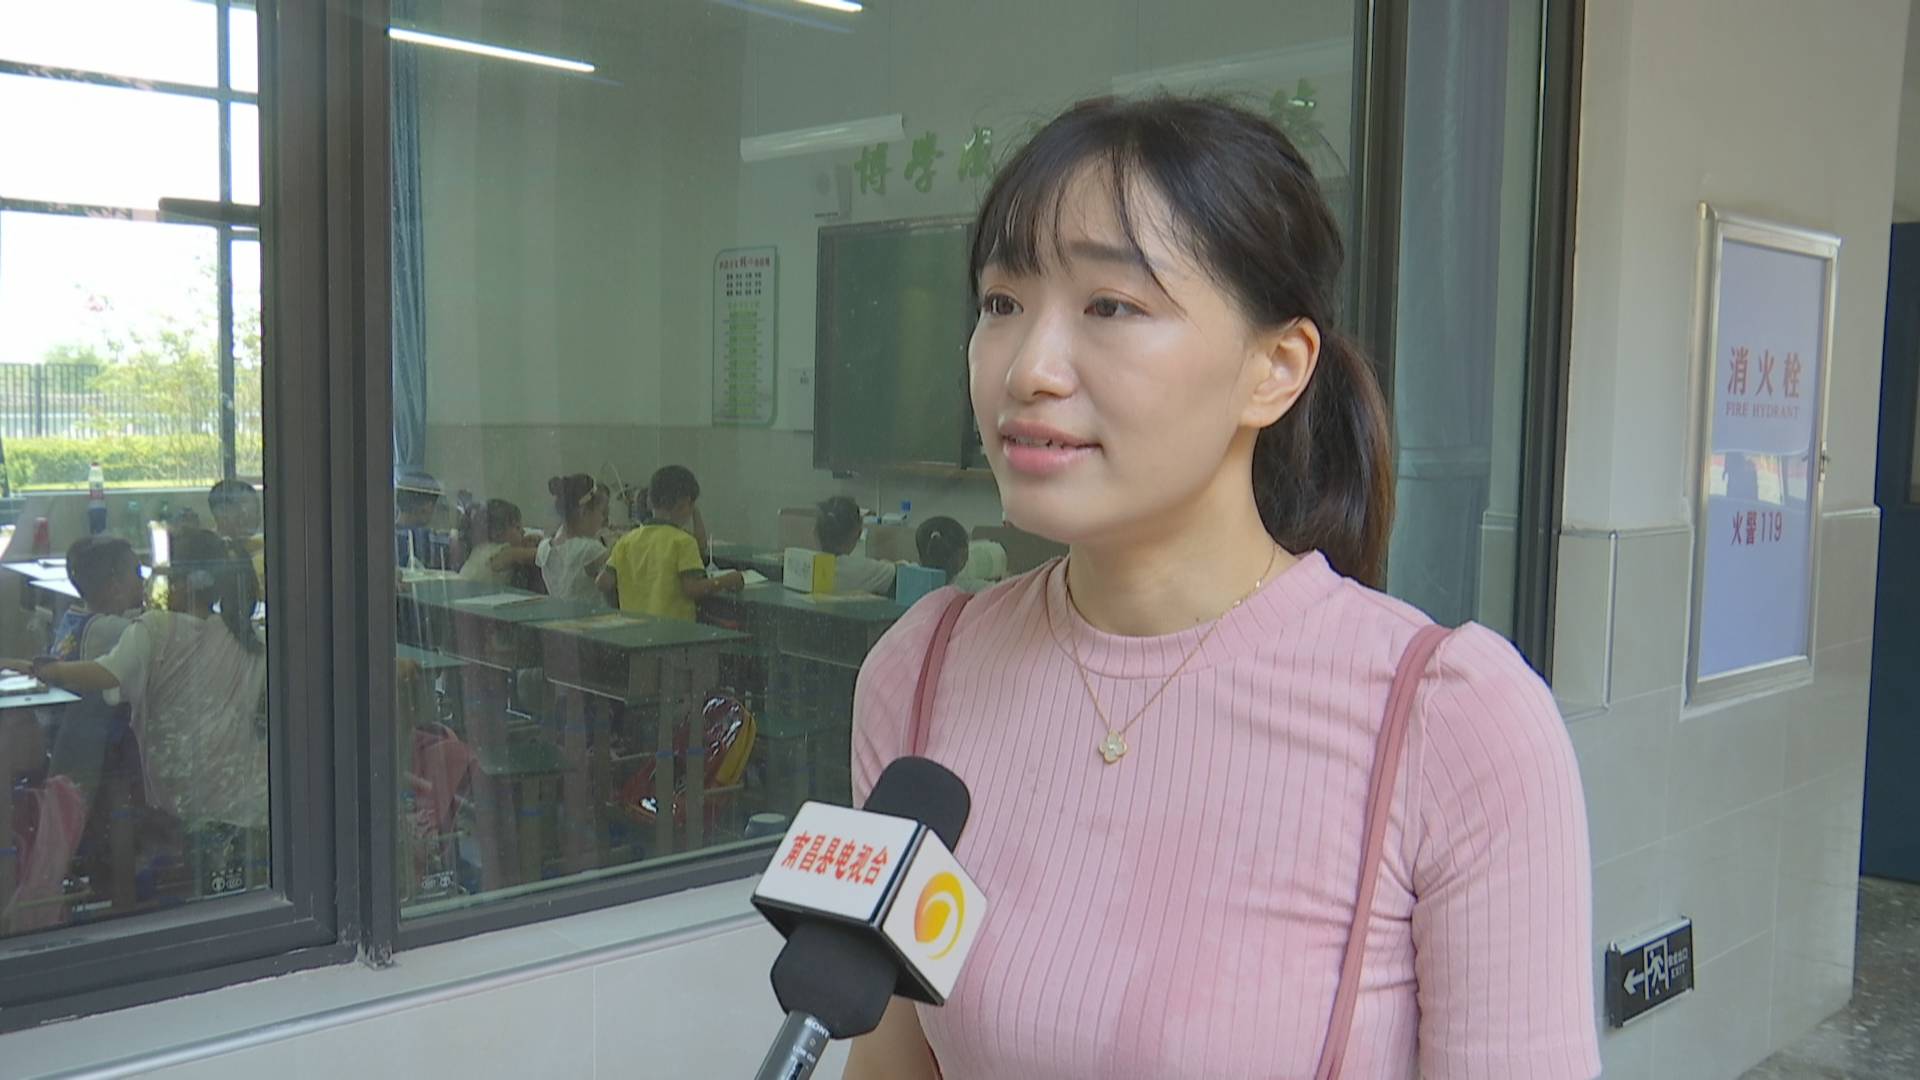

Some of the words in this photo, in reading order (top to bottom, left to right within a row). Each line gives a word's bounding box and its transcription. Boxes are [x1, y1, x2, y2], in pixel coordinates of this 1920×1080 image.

[1728, 345, 1801, 399] 消火栓
[1726, 401, 1749, 417] FIRE
[1752, 403, 1800, 420] HYDRANT
[1731, 512, 1782, 545] 火警119
[781, 830, 888, 885] 南昌县电视台
